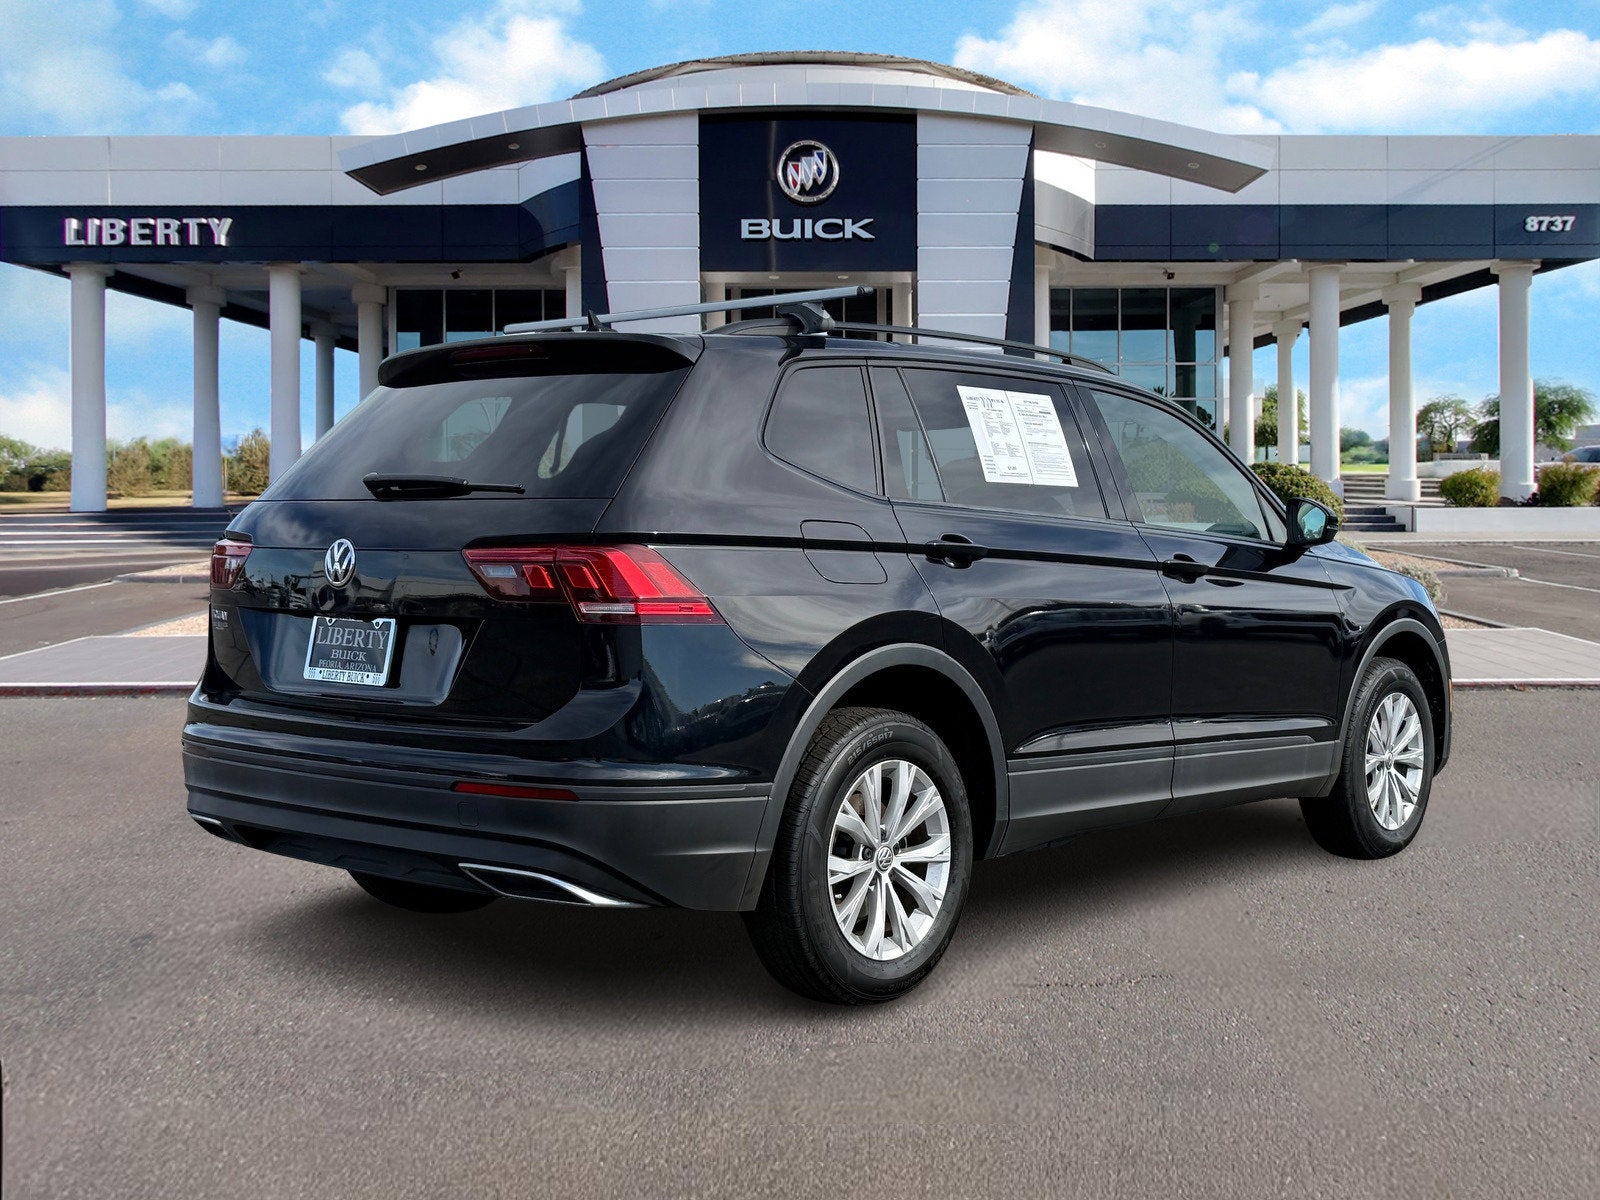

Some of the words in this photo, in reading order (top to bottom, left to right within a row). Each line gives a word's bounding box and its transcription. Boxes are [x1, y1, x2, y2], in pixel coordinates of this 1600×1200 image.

[64, 217, 233, 246] LIBERTY
[741, 218, 875, 239] BUICK
[1524, 215, 1576, 232] 8737
[316, 626, 389, 650] LIBERTY
[331, 649, 367, 662] BUICK
[322, 670, 347, 681] LIBERTY
[347, 672, 366, 683] BUICK
[343, 662, 377, 673] ARIZONA
[847, 730, 894, 765] 215/65R17
